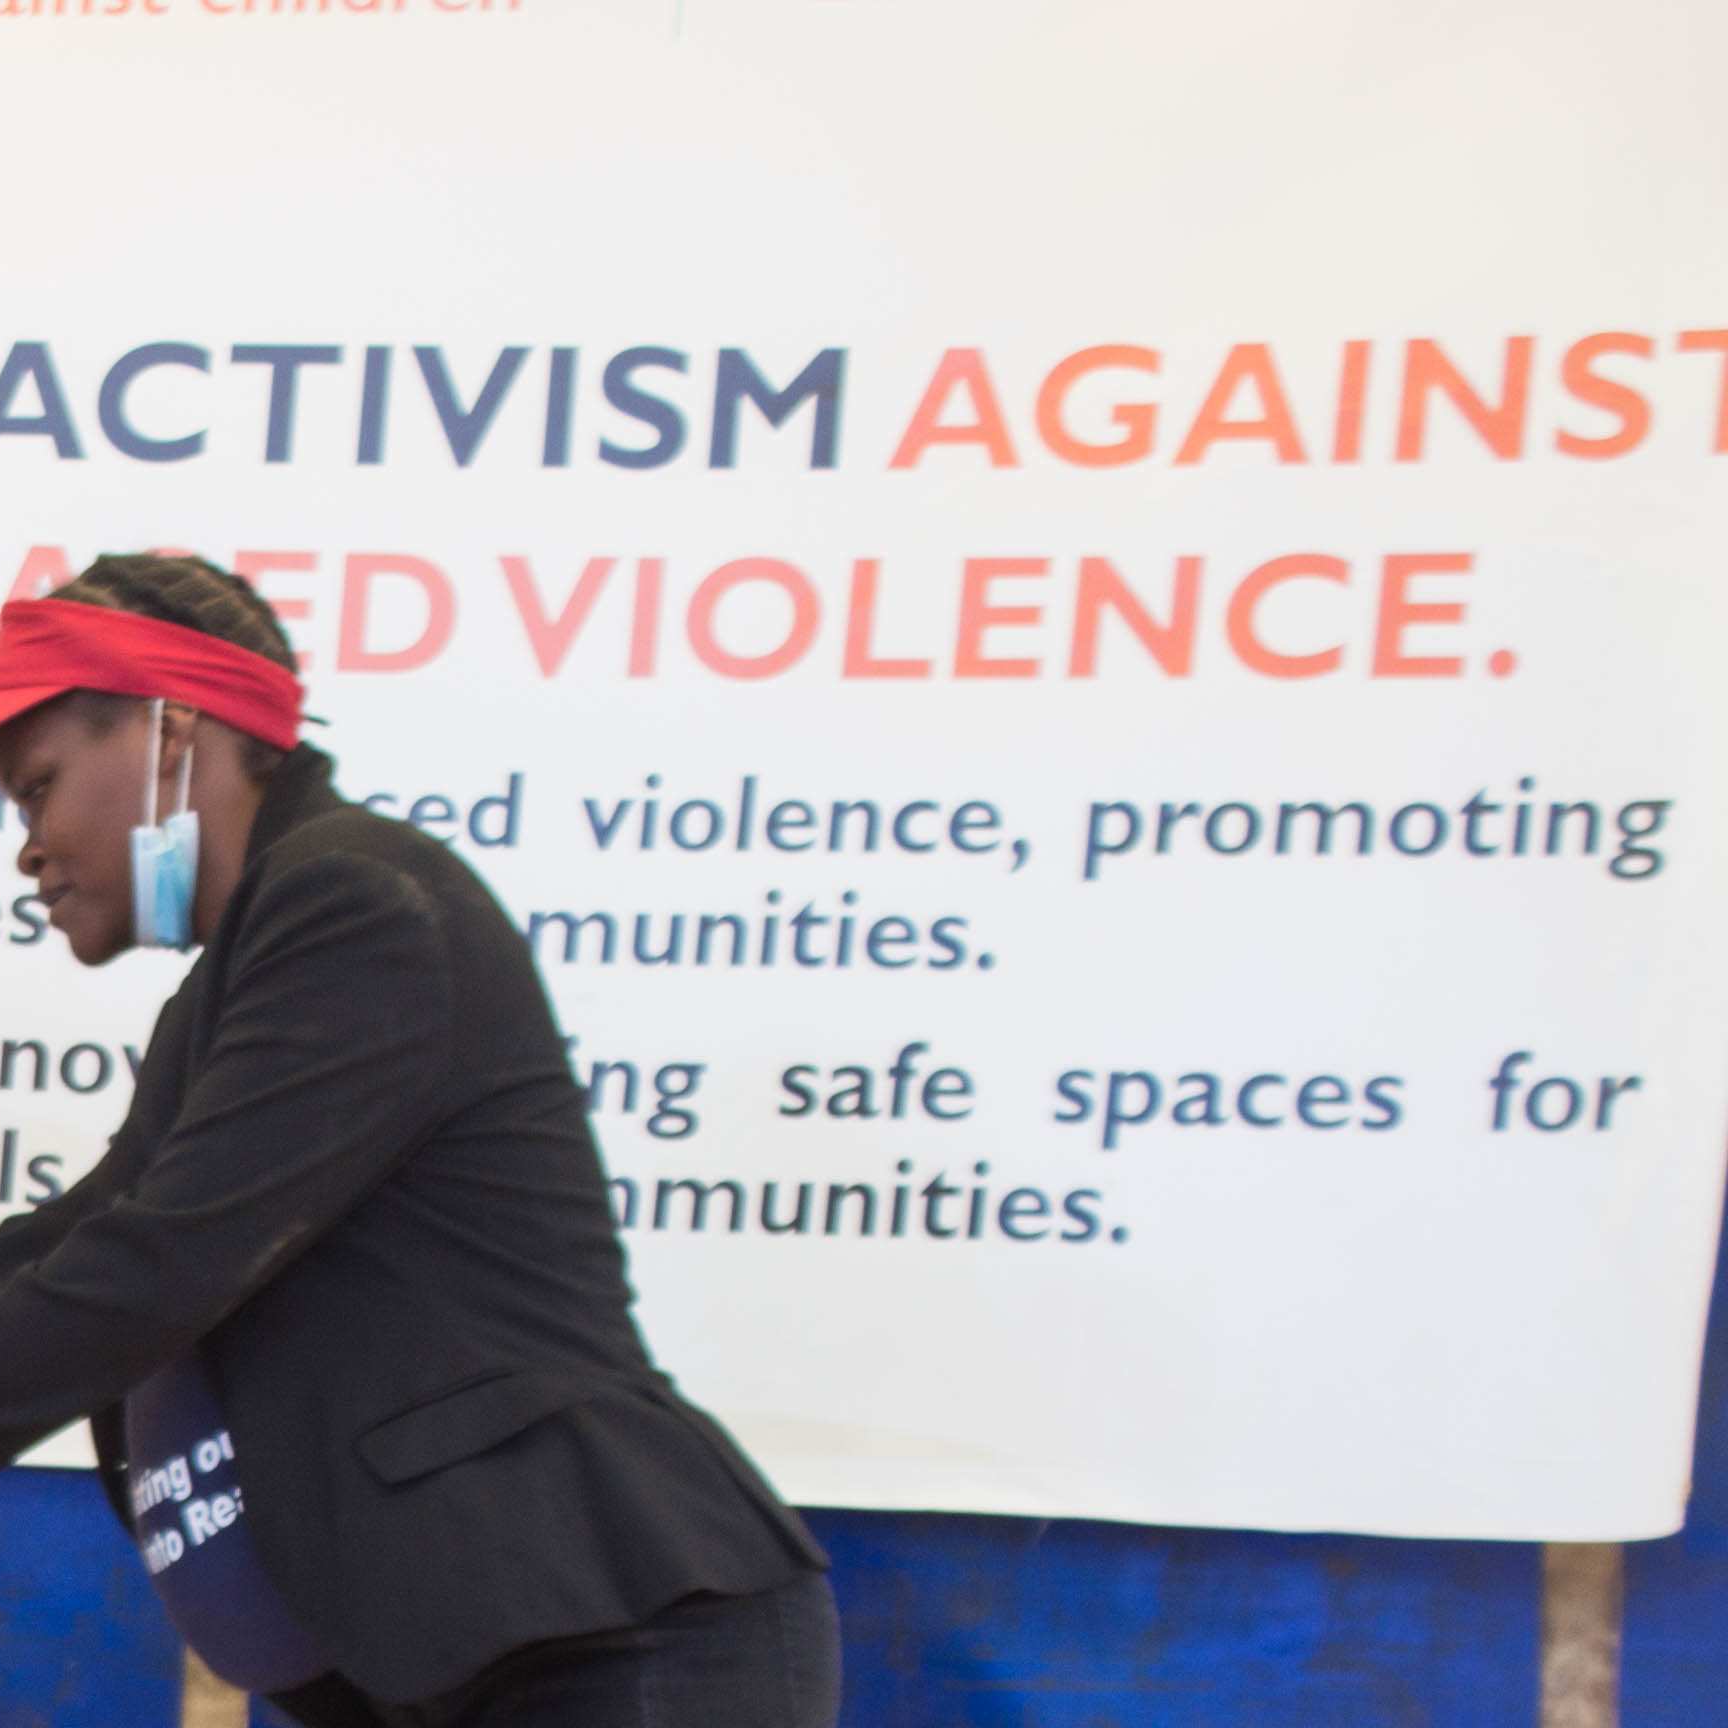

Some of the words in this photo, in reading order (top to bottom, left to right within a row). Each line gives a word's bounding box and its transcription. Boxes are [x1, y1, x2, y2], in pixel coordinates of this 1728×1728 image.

[888, 328, 1728, 469] AGAINST
[497, 552, 1519, 681] VIOLENCE.
[581, 774, 1032, 872] violence,
[1081, 776, 1674, 881] promoting
[528, 889, 997, 971] munities.
[777, 1042, 976, 1121] safe
[1052, 1066, 1405, 1150] spaces
[1488, 1050, 1644, 1131] for
